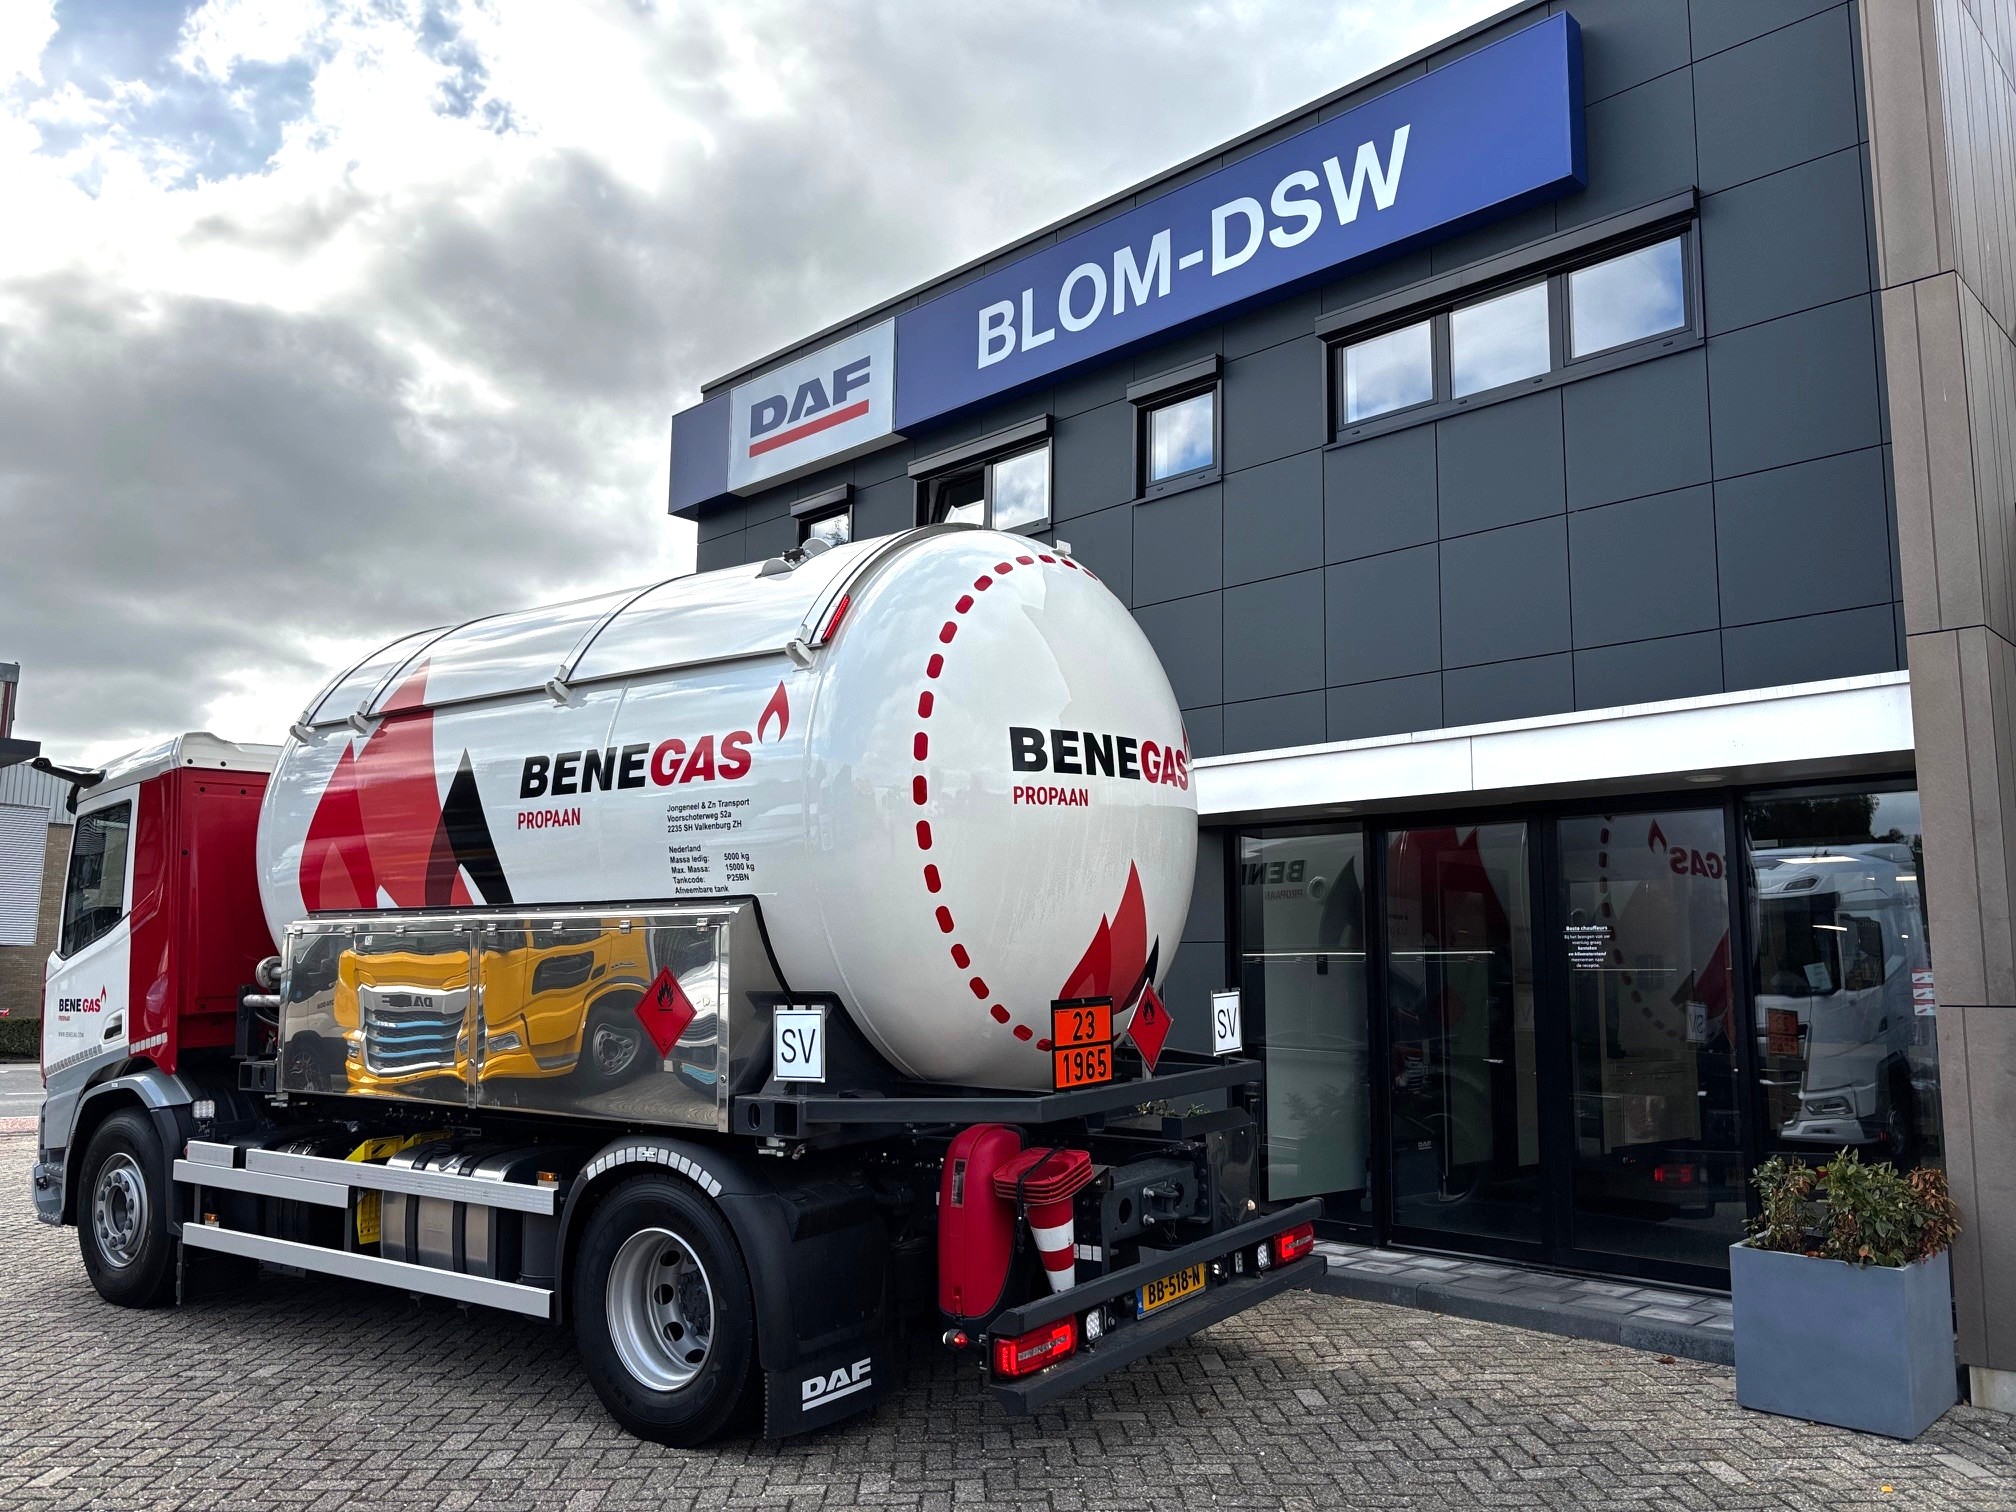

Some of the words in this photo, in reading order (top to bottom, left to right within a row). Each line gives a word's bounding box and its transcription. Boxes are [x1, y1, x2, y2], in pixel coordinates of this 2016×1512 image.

[978, 124, 1411, 370] BLOM-DSW
[750, 355, 871, 438] DAF
[519, 730, 753, 799] BENEGAS
[1009, 726, 1189, 791] BENEGAS
[667, 802, 699, 813] Jongeneel
[707, 801, 716, 809] Zn
[718, 799, 750, 808] Transport
[1013, 786, 1089, 806] PROPAAN
[517, 807, 581, 830] PROPAAN
[667, 812, 718, 823] Voorschoterweg
[720, 811, 731, 819] 52a
[667, 825, 682, 833] 2235
[694, 822, 731, 831] Valkenburg
[732, 820, 742, 828] ZH
[669, 844, 701, 853] Nederland
[670, 856, 690, 864] Massa
[691, 855, 709, 863] ledig:
[724, 853, 739, 861] 5000
[741, 852, 750, 861] kg
[671, 866, 686, 874] Max.
[688, 865, 710, 873] Massa:
[725, 863, 744, 871] 15000
[746, 862, 755, 871] kg
[673, 876, 706, 884] Tankcode:
[727, 873, 749, 881] P25BN
[675, 886, 713, 894] Afneembare
[58, 998, 101, 1013] BENEGAS
[1072, 1010, 1095, 1041] 23
[1217, 1007, 1237, 1039] SV
[781, 1028, 816, 1064] SV
[1063, 1048, 1107, 1084] 1965
[1148, 1265, 1200, 1305] BB-518-N
[802, 1357, 871, 1400] DAF
